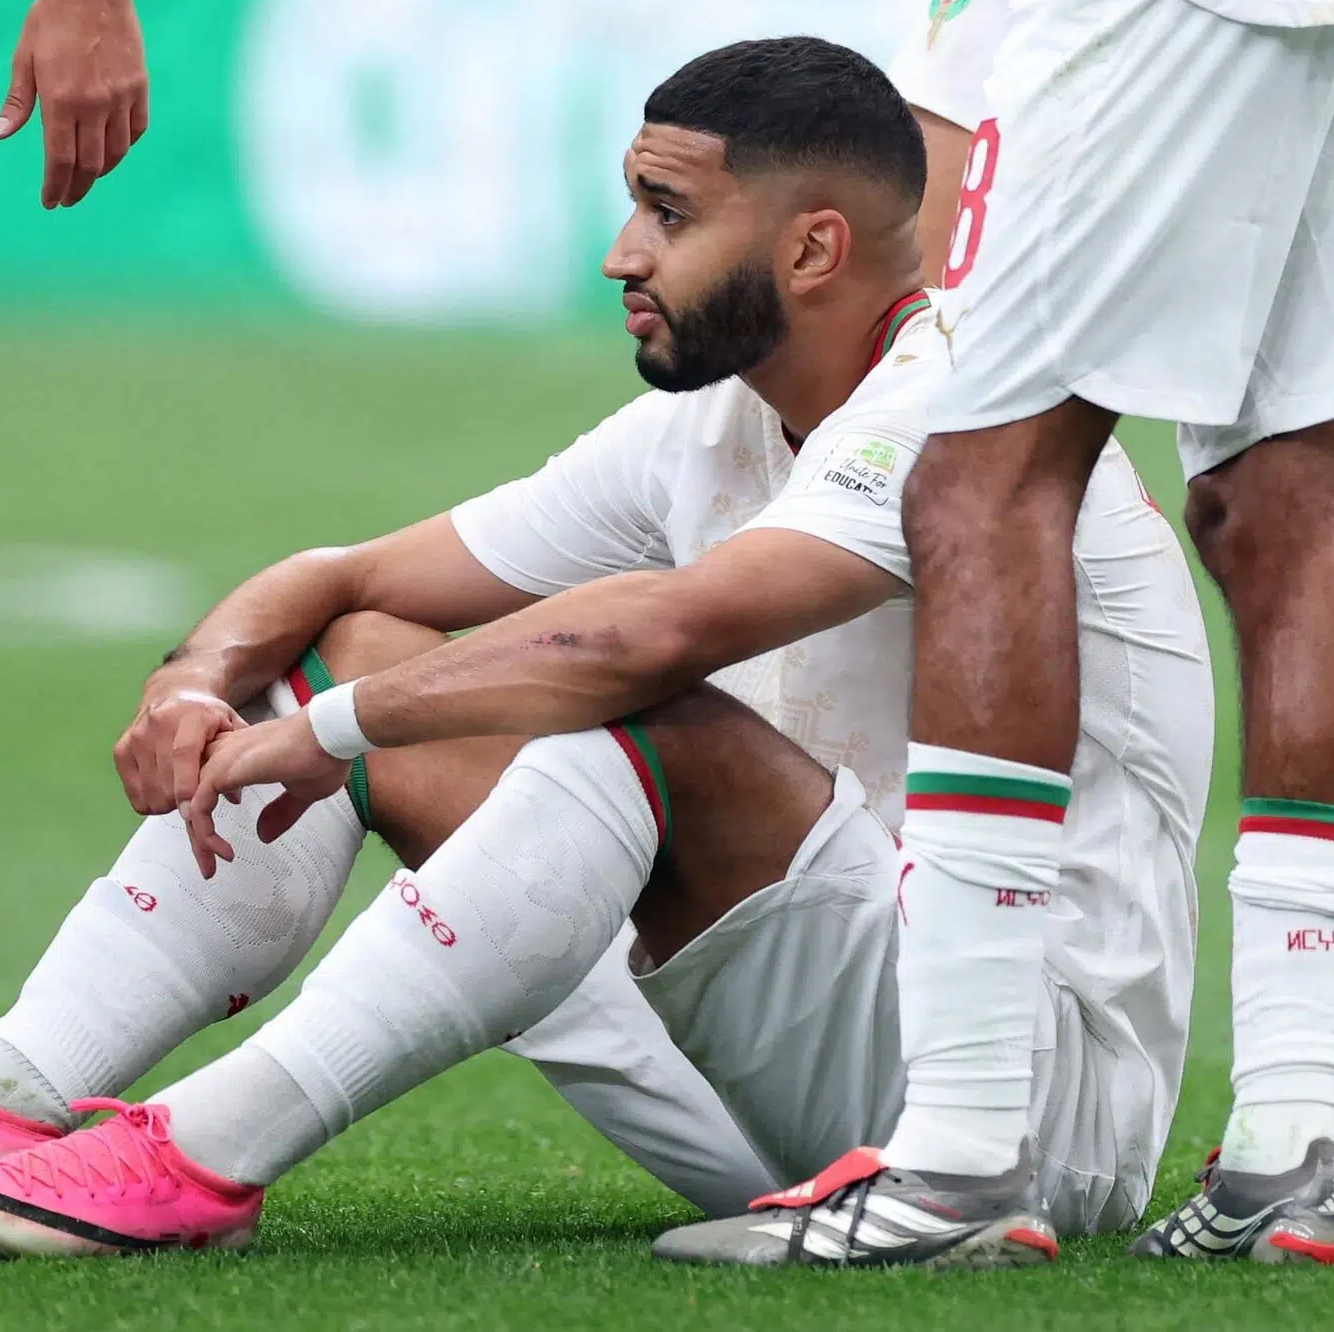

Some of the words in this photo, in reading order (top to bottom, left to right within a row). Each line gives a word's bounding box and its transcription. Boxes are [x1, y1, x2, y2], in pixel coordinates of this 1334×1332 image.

[943, 117, 1001, 290] 8
[824, 469, 878, 495] EDUCAT
[870, 472, 887, 489] For
